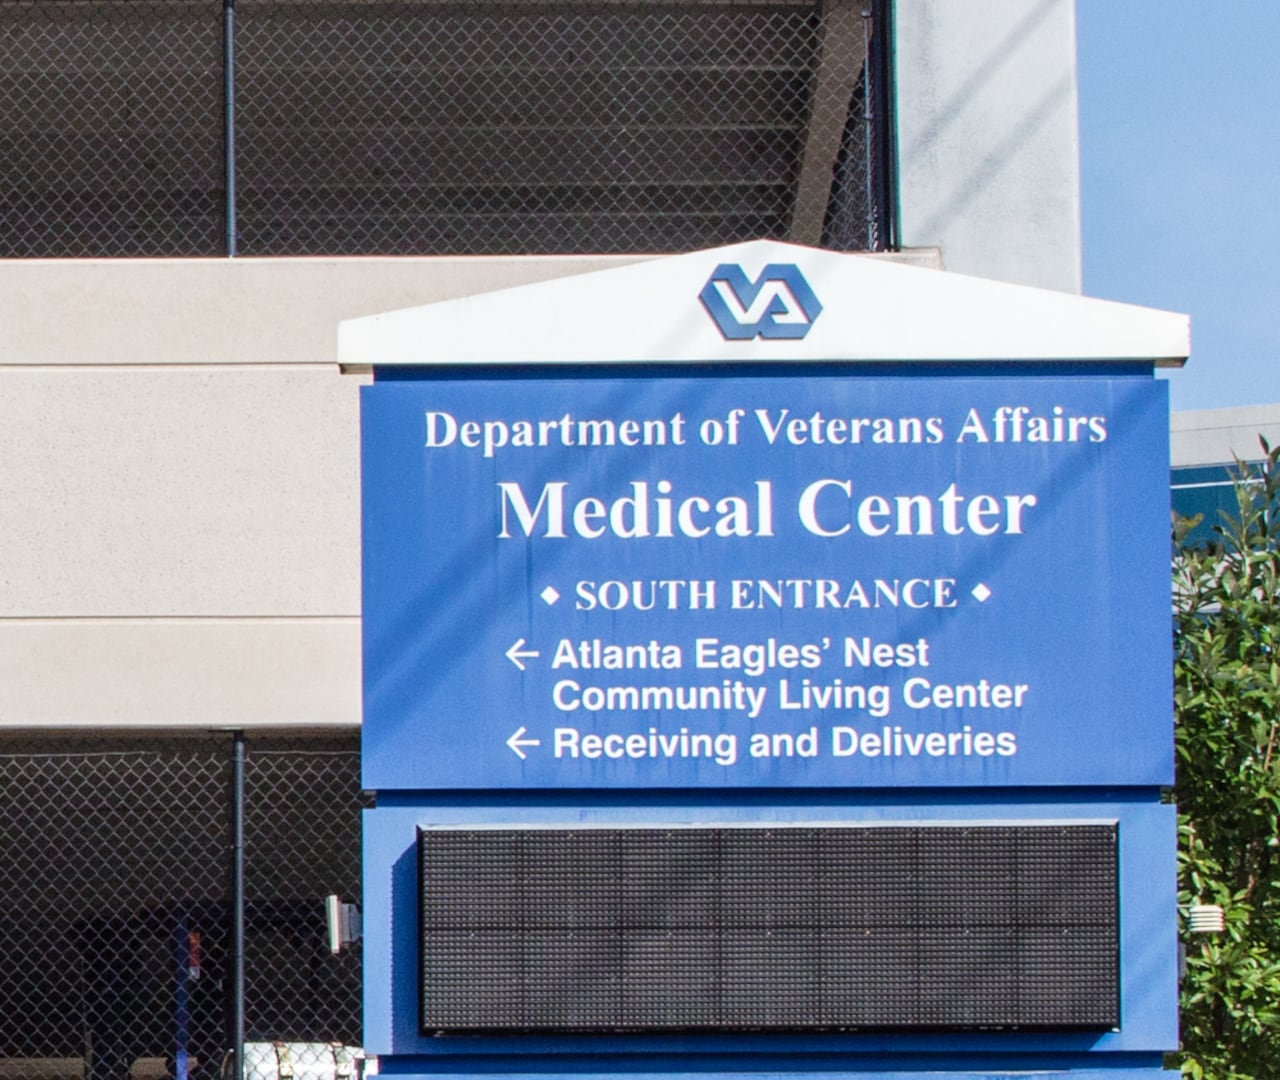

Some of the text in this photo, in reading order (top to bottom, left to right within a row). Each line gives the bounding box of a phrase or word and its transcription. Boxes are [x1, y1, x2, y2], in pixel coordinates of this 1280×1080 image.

[423, 405, 1108, 458] Department of Veterans Affairs
[496, 478, 1038, 539] Medical Center
[574, 578, 958, 611] SOUTH ENTRANCE
[551, 638, 682, 670] Atlanta
[844, 637, 930, 668] Nest
[552, 677, 1029, 719] Community Living Center
[554, 725, 1018, 766] Receiving and Deliveries
